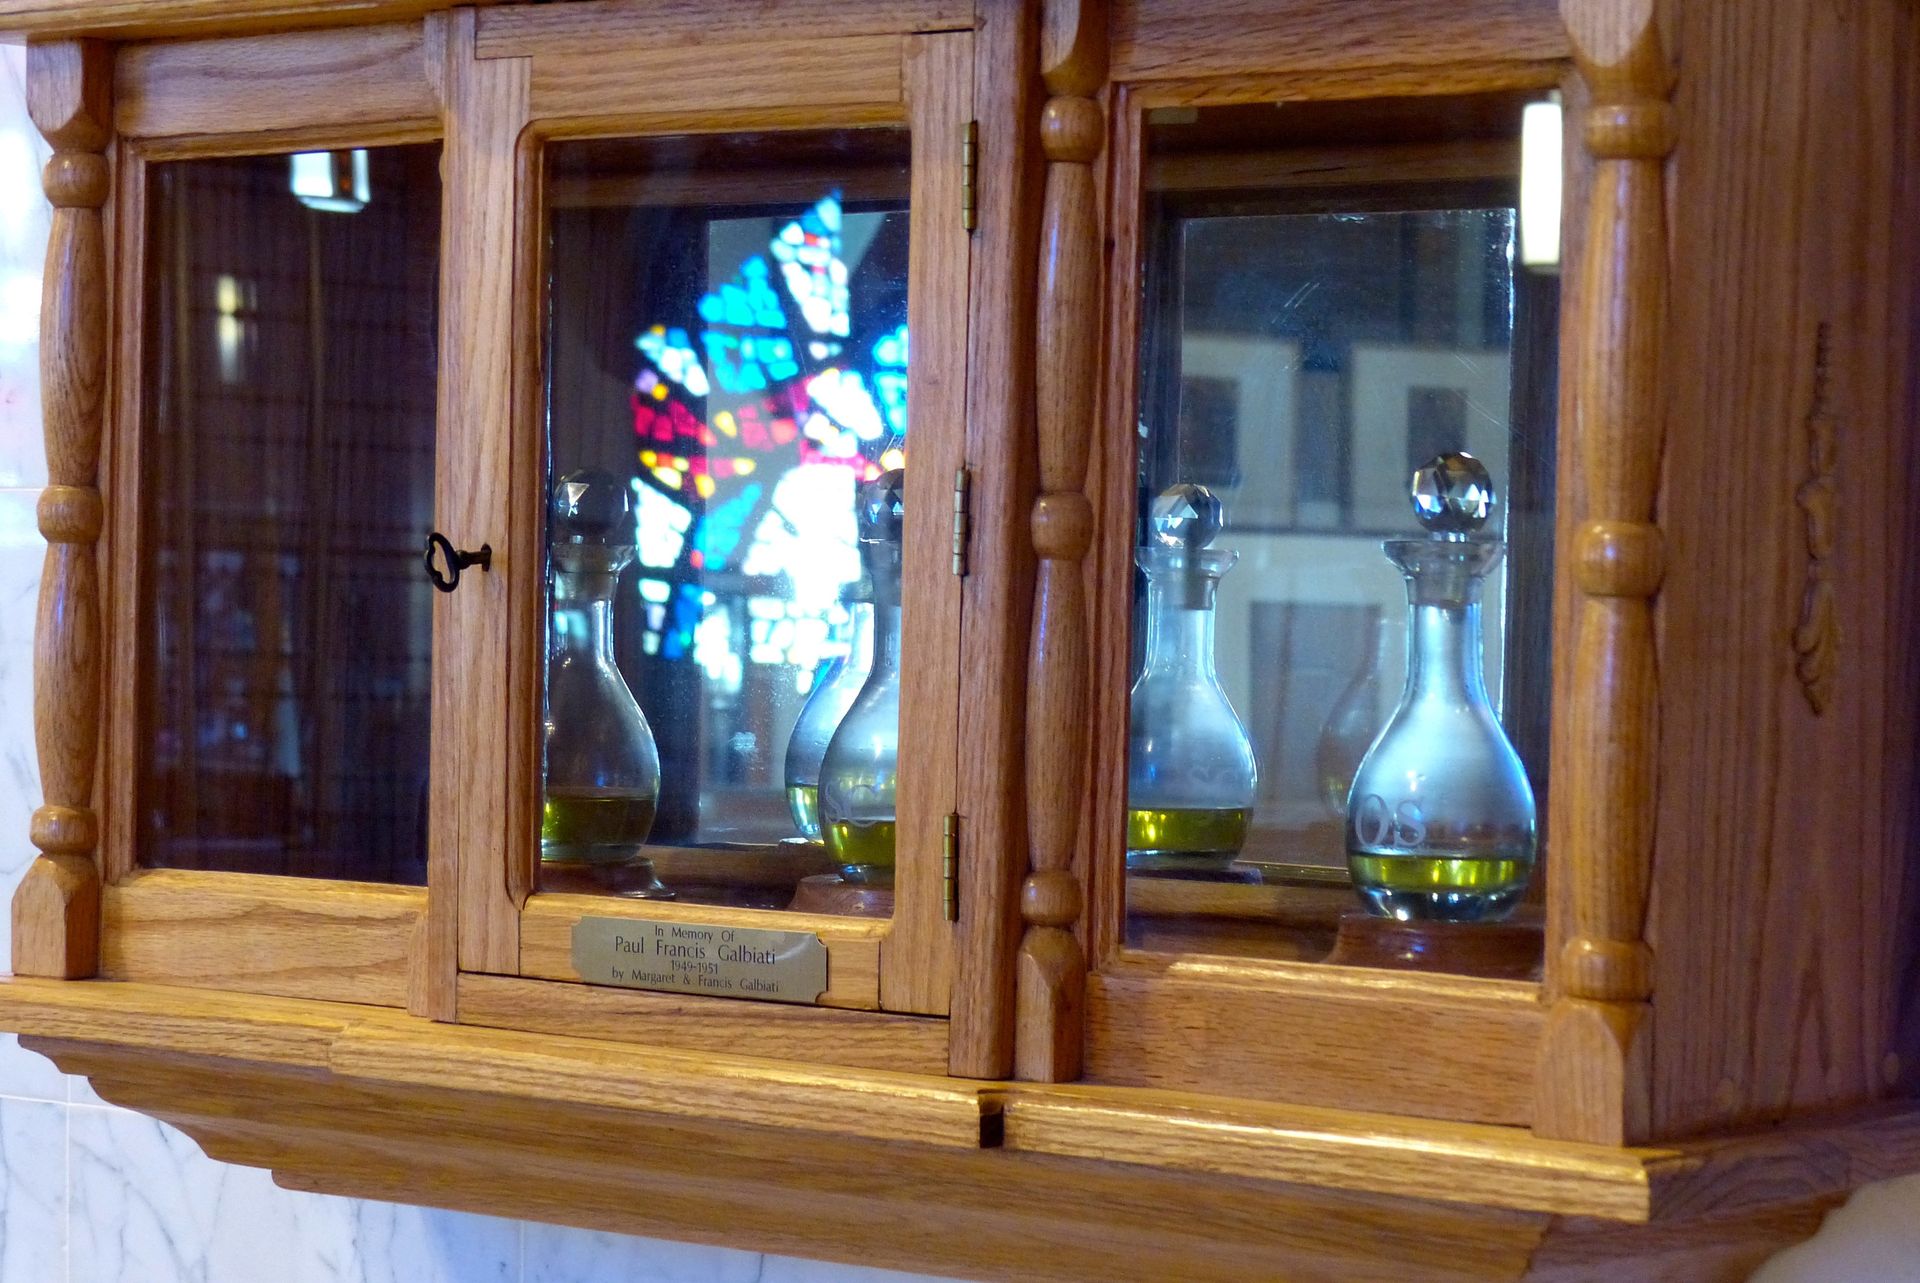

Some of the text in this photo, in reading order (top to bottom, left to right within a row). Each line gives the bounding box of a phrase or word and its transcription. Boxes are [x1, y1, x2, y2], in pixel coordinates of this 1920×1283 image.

[655, 924, 735, 944] In Memory Of
[615, 935, 775, 965] Paul Francis Galbiati
[671, 959, 718, 975] 1949-1951
[612, 966, 779, 993] by Margaret & Francis Galbiati
